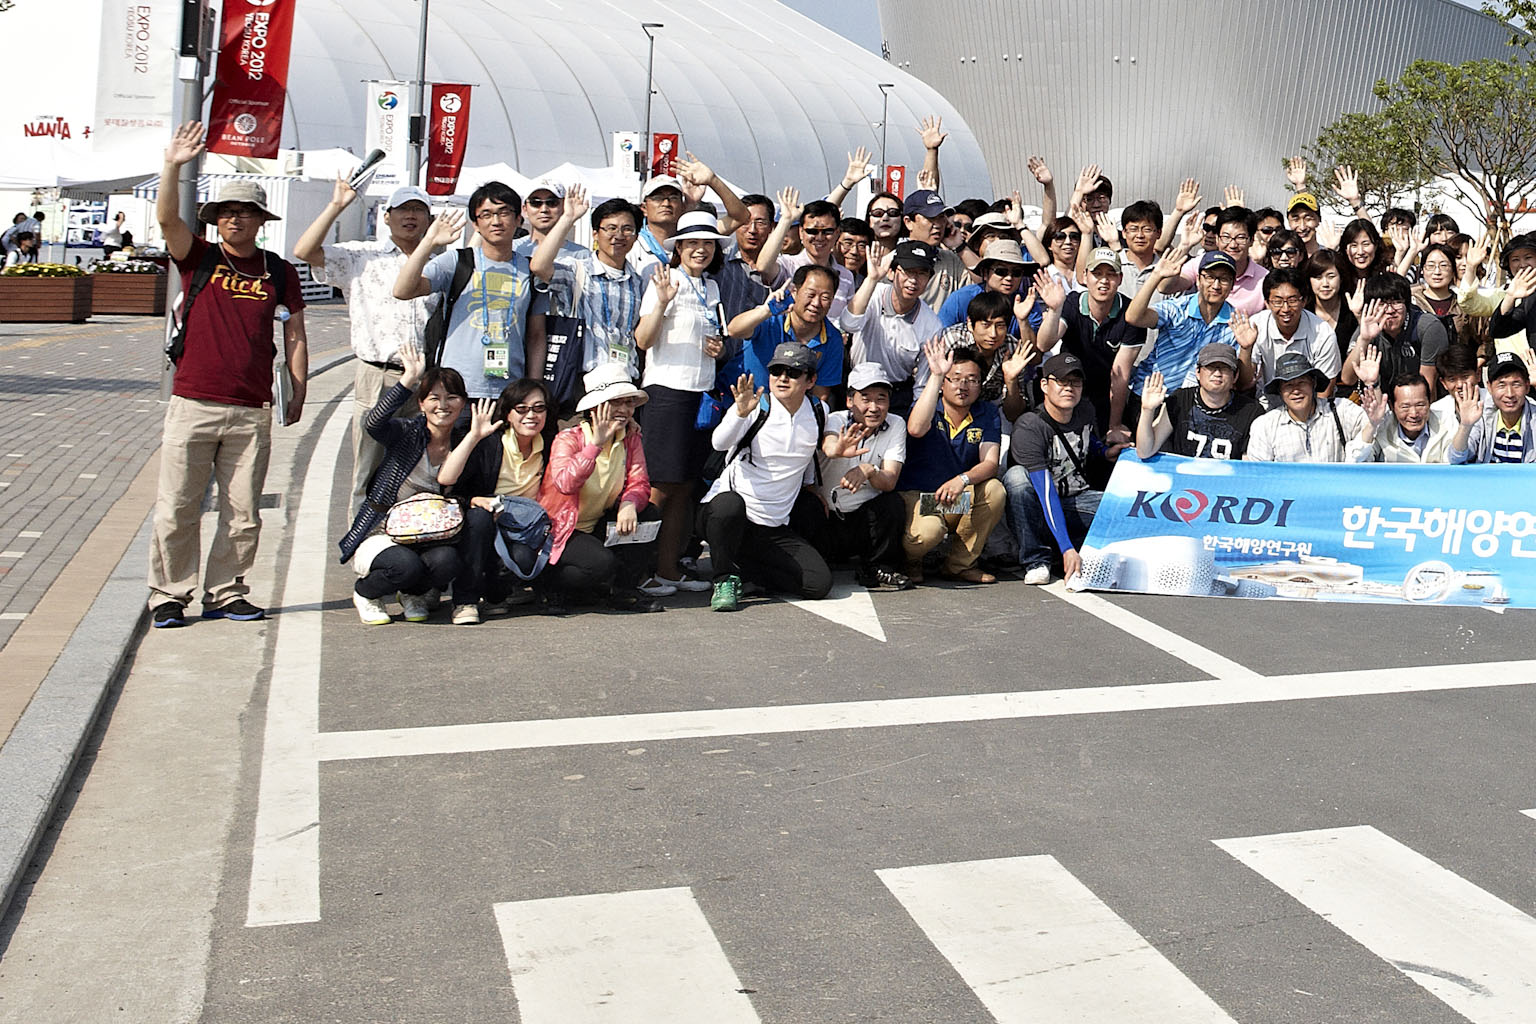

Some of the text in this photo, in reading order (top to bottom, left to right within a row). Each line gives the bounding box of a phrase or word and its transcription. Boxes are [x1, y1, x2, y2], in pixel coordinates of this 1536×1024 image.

[134, 5, 151, 74] EXPO 2012
[248, 12, 270, 81] EXPO 2012
[239, 39, 251, 66] KOREA
[24, 117, 71, 140] NANTA
[221, 133, 243, 142] BEAN
[446, 116, 456, 136] EXPO
[444, 137, 455, 154] 2012
[210, 264, 268, 298] Fitch
[1126, 488, 1296, 527] KORDI
[1202, 533, 1313, 557] 한국해양연구원
